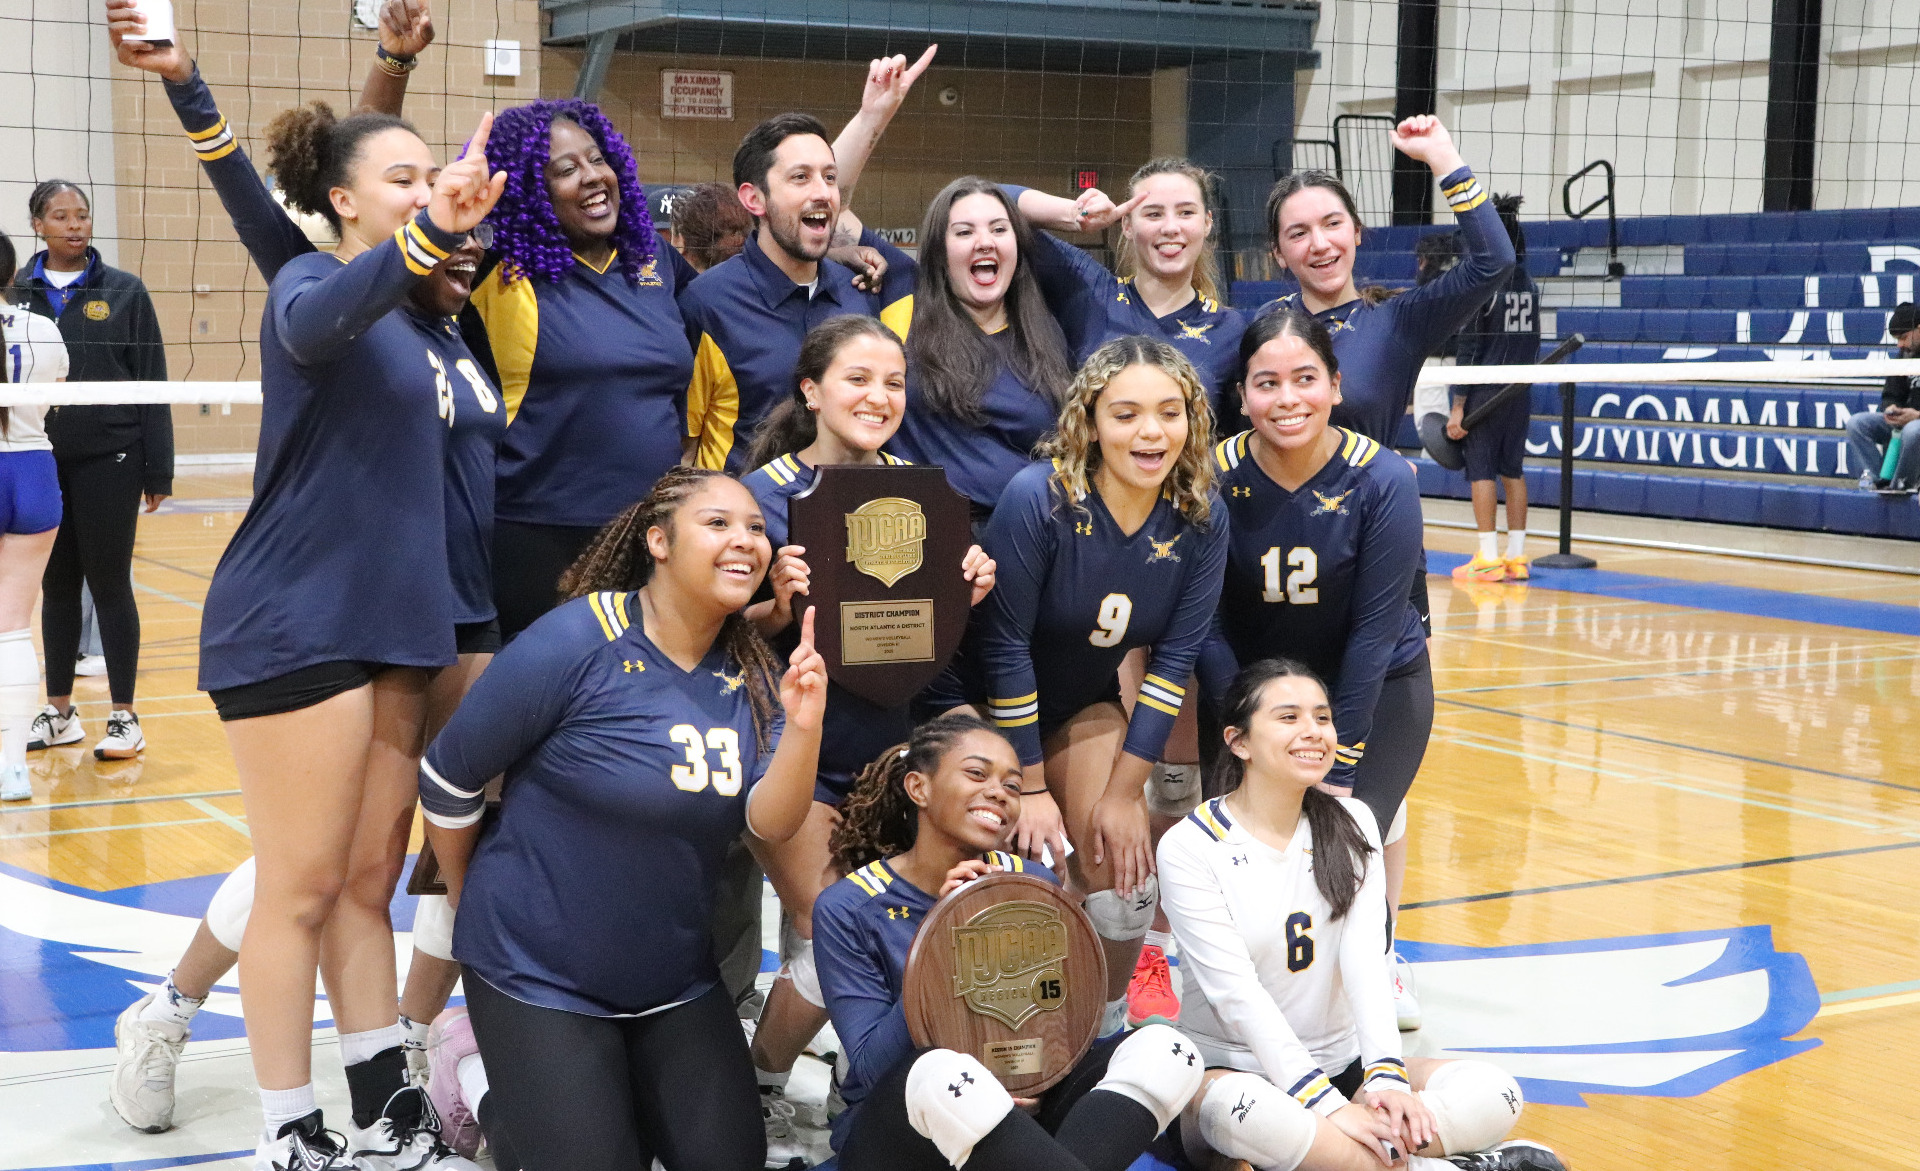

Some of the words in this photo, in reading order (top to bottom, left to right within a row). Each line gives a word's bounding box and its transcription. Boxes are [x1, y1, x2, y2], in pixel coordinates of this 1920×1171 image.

[670, 86, 724, 96] OCCUPANCY
[674, 75, 721, 85] MAXIMUM
[687, 106, 727, 115] PERSONS
[1504, 291, 1533, 332] 22
[455, 358, 498, 414] 8
[846, 513, 926, 561] NJCAA
[1260, 546, 1319, 605] 12
[854, 611, 885, 619] DISTRICT
[886, 609, 920, 618] CHAMPION
[1088, 593, 1133, 648] 9
[669, 724, 743, 797] 33
[954, 923, 1067, 995] NJCAA
[1285, 910, 1315, 973] 6
[1040, 980, 1061, 999] 15
